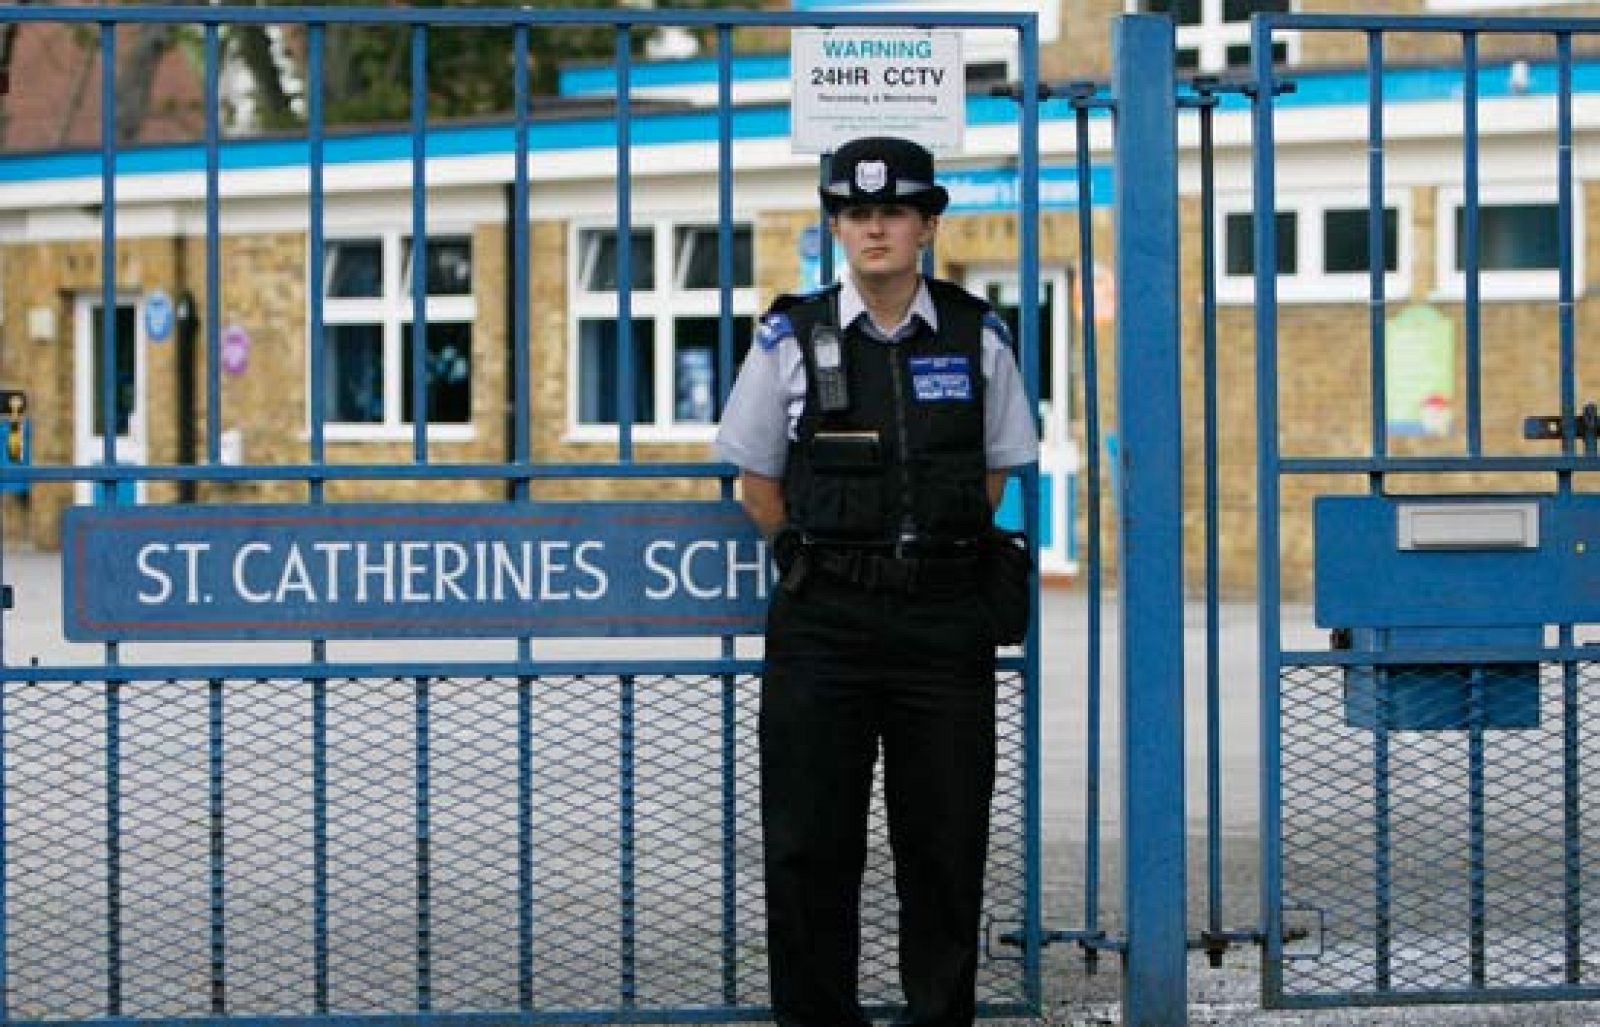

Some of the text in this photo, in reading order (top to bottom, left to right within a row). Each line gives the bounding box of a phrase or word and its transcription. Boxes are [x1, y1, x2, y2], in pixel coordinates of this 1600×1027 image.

[823, 40, 932, 59] WARNING
[811, 67, 944, 86] 24HR CCTV
[136, 540, 780, 604] ST. CATHERINES SCH
